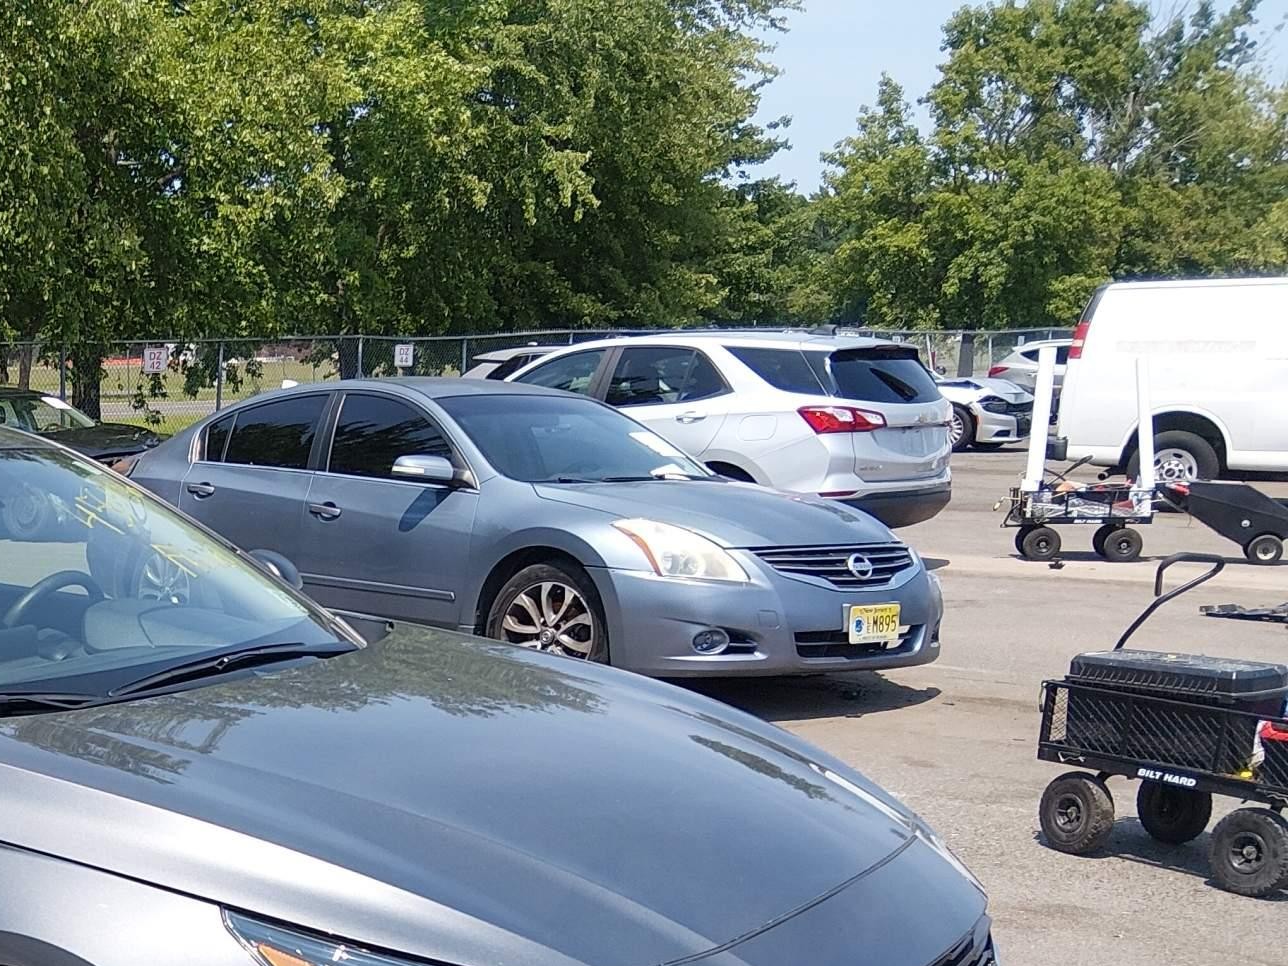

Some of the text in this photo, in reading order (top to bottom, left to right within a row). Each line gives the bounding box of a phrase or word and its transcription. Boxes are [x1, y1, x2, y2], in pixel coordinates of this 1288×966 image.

[149, 351, 162, 361] DZ
[1137, 768, 1197, 787] BILT HARD
